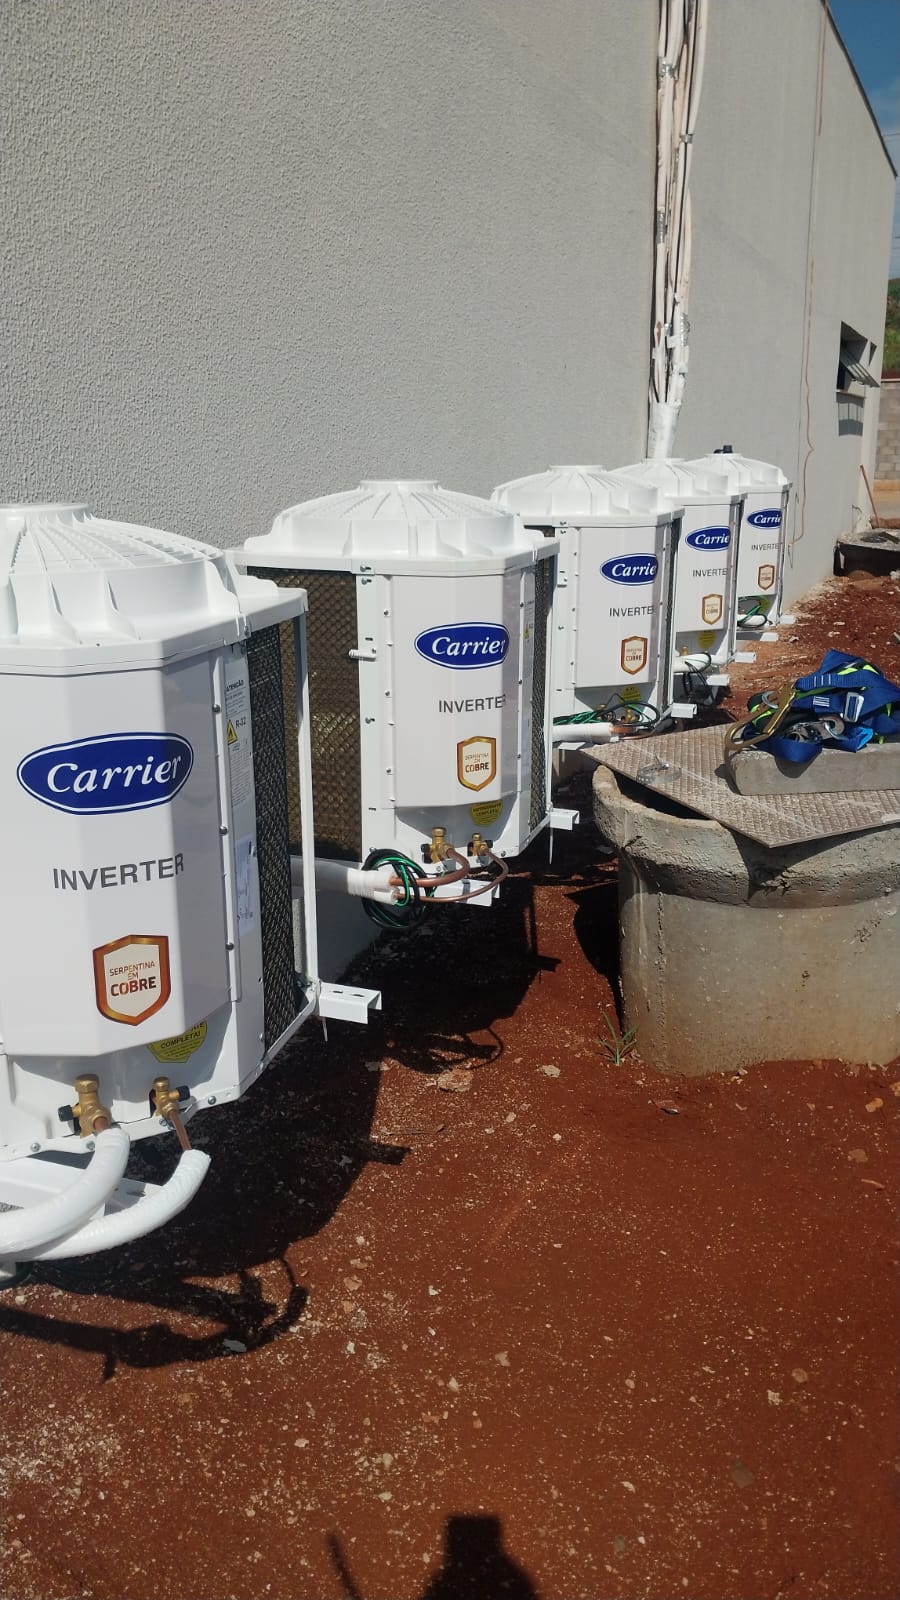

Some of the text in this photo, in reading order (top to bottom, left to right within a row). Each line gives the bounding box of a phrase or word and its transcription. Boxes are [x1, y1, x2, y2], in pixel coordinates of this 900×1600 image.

[753, 513, 782, 524] Carri
[694, 533, 730, 545] Carrie
[751, 543, 780, 551] INVERTE
[611, 562, 657, 577] Carrie
[692, 568, 728, 577] INVERTE
[609, 605, 654, 617] INVERTE
[431, 636, 506, 656] Carrier
[465, 762, 489, 773] COBRE
[47, 755, 182, 793] Carrier
[53, 853, 184, 891] INVERTER
[109, 960, 155, 977] SERPENTINA
[128, 972, 139, 980] EM
[111, 976, 157, 997] COBRE
